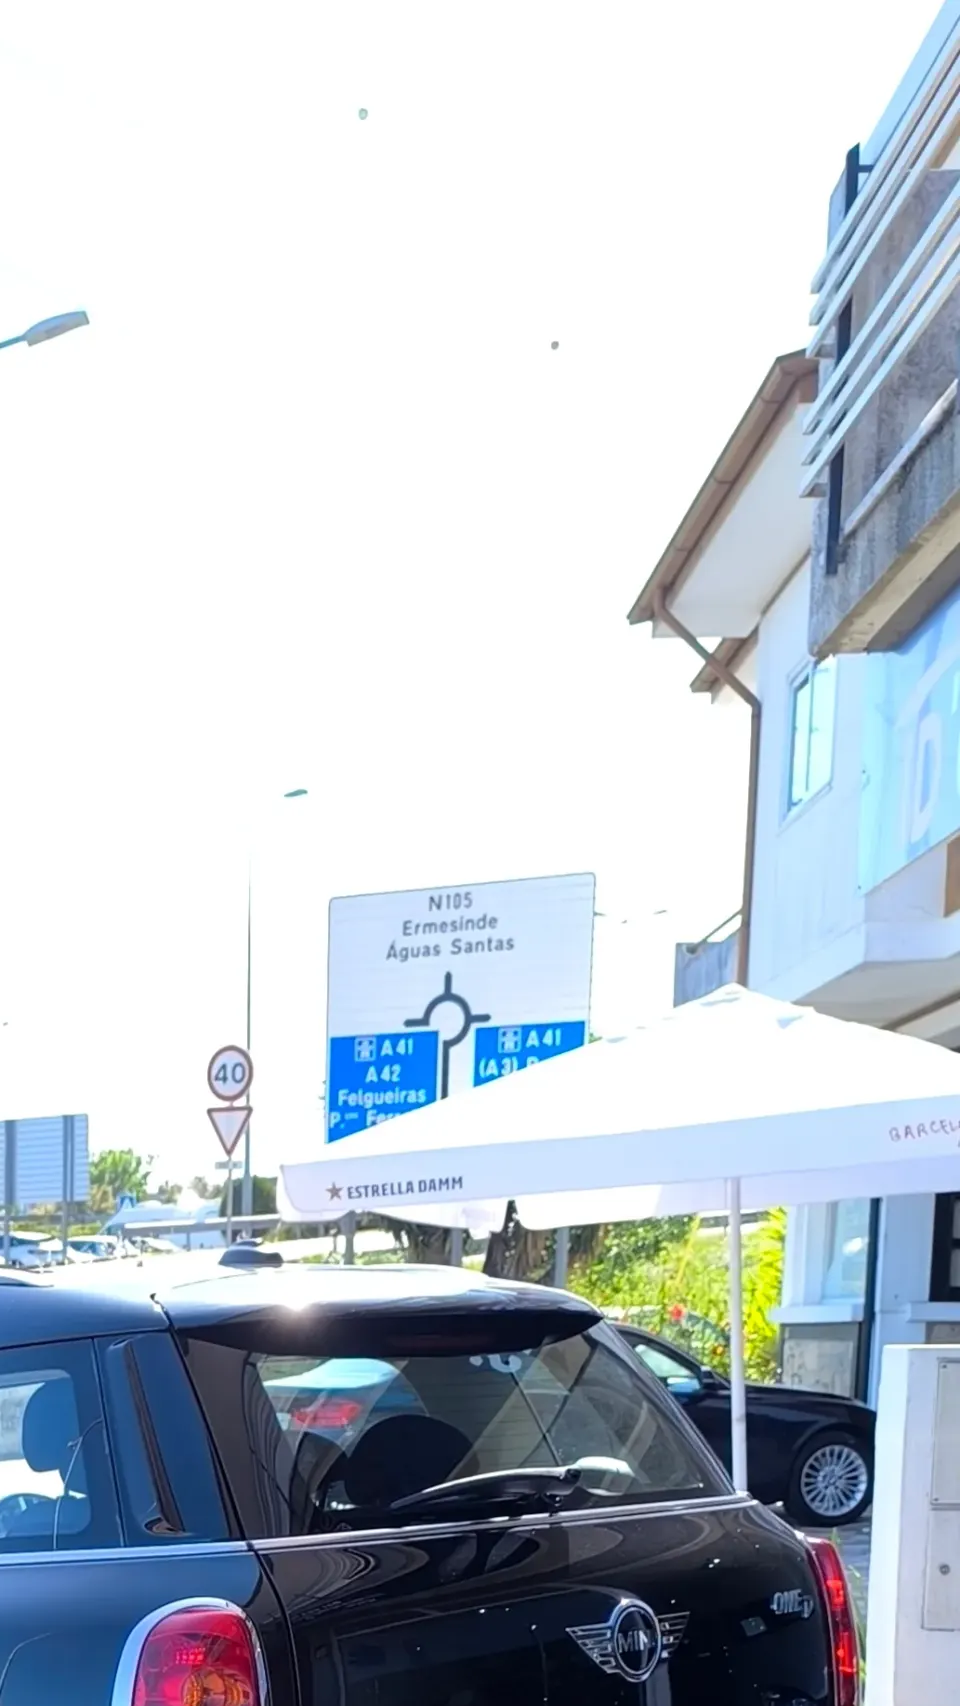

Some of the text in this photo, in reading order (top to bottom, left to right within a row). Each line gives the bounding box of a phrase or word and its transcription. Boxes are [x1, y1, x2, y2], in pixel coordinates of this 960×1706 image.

[428, 891, 473, 912] N105
[402, 914, 498, 937] Ermesinde
[386, 937, 515, 963] Águas Santas
[214, 1062, 246, 1084] 40
[338, 1086, 427, 1109] Felgueiras
[347, 1176, 463, 1199] ESTRELLA DAMM
[618, 1630, 657, 1652] MIN
